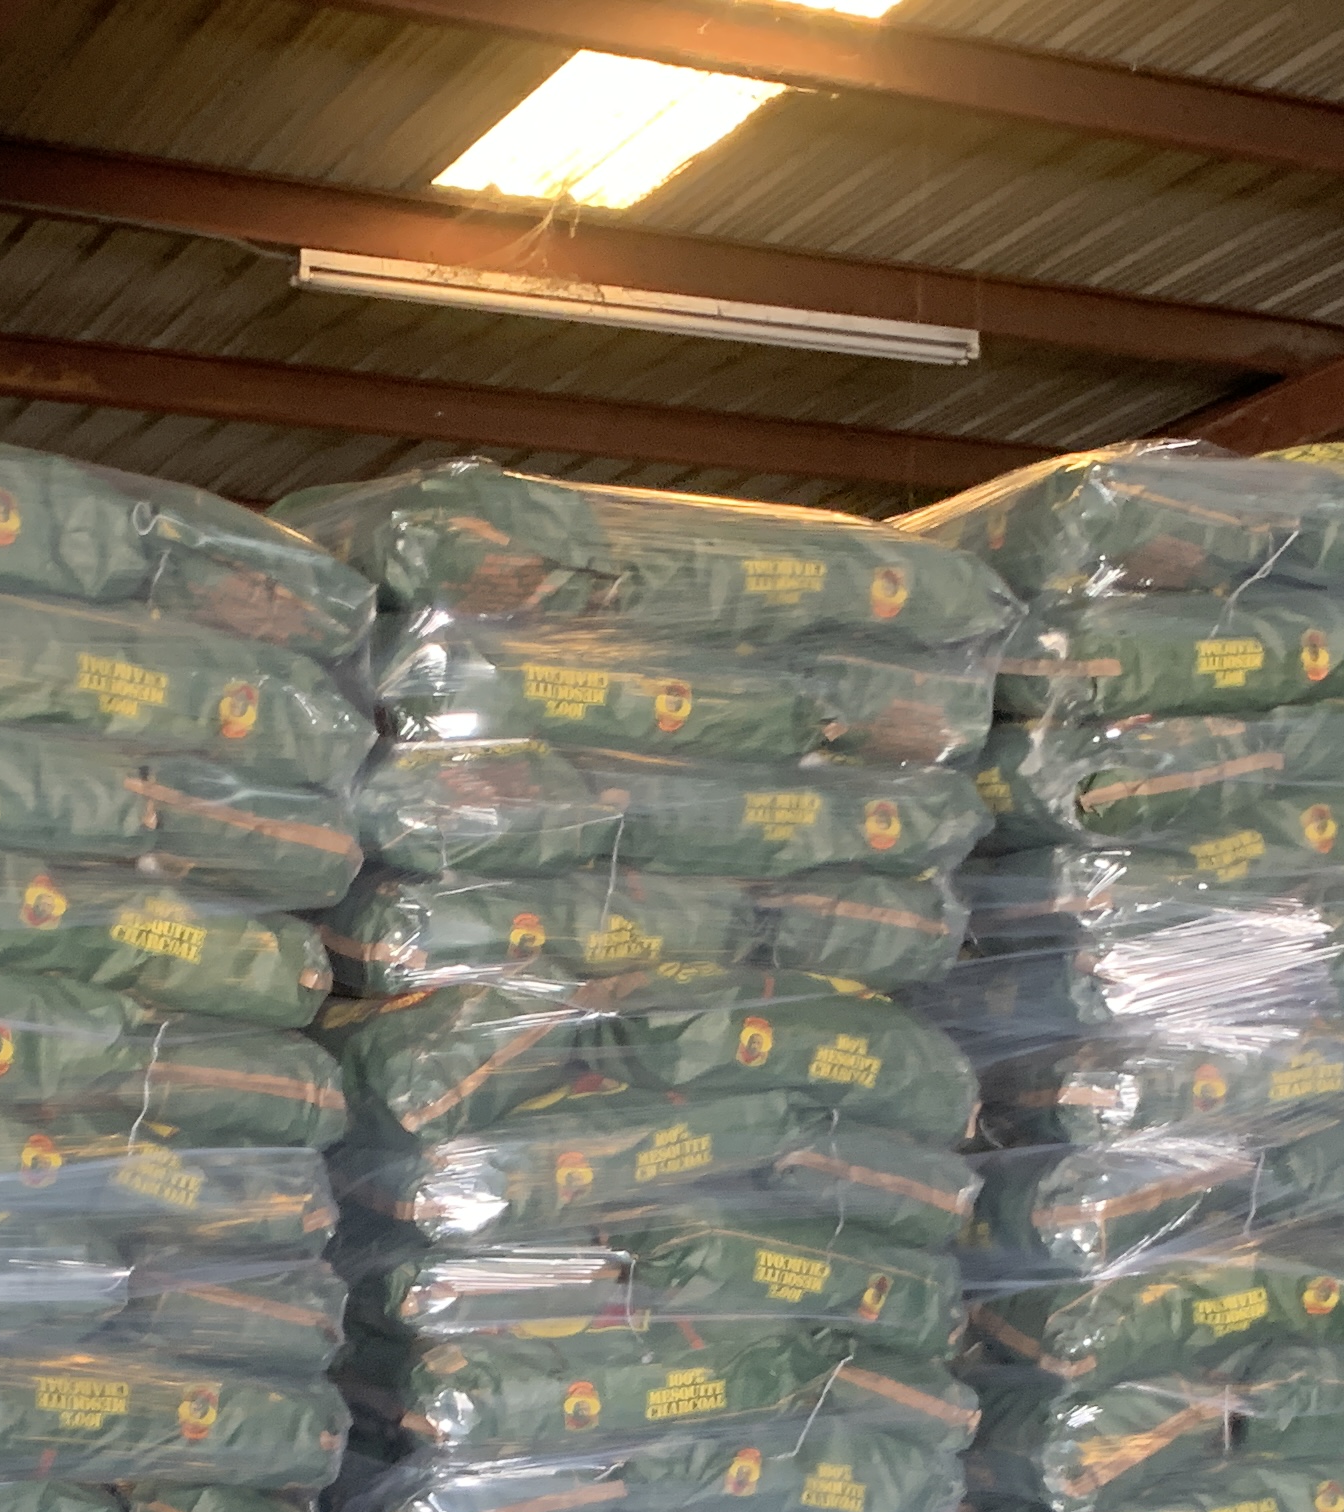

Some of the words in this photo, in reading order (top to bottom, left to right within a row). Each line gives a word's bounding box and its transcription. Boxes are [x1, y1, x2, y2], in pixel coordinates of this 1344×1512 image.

[111, 925, 202, 963] CHARCOAL
[37, 1392, 127, 1413] MESQUITE
[647, 1381, 726, 1406] MESQUITE
[646, 1393, 726, 1420] CHARCOAL
[59, 1410, 103, 1429] 100%
